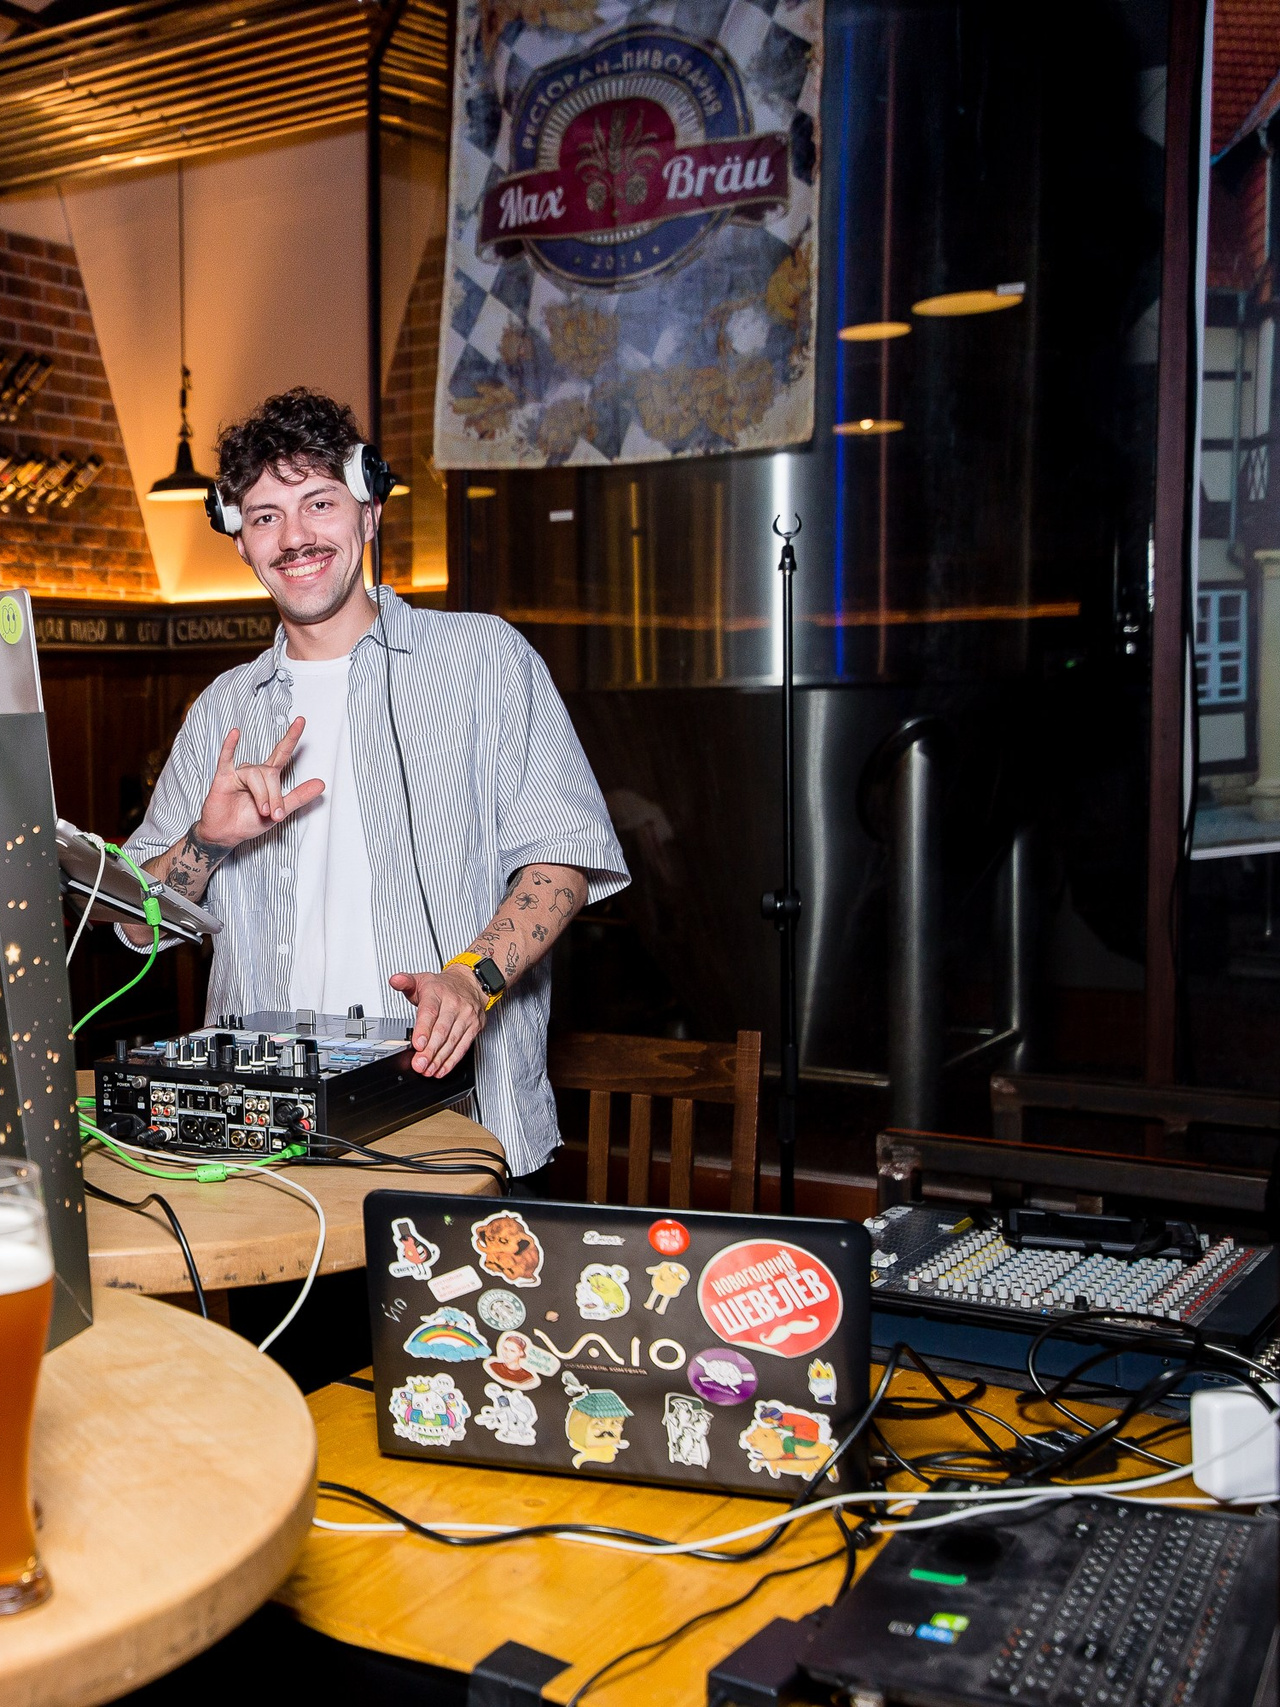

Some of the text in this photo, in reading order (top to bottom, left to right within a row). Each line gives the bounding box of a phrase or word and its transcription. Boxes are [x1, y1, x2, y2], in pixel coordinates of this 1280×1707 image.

[499, 154, 775, 230] Max Bräu
[709, 1249, 798, 1298] НОВОГОДНИЙ
[533, 1328, 687, 1371] VAIO
